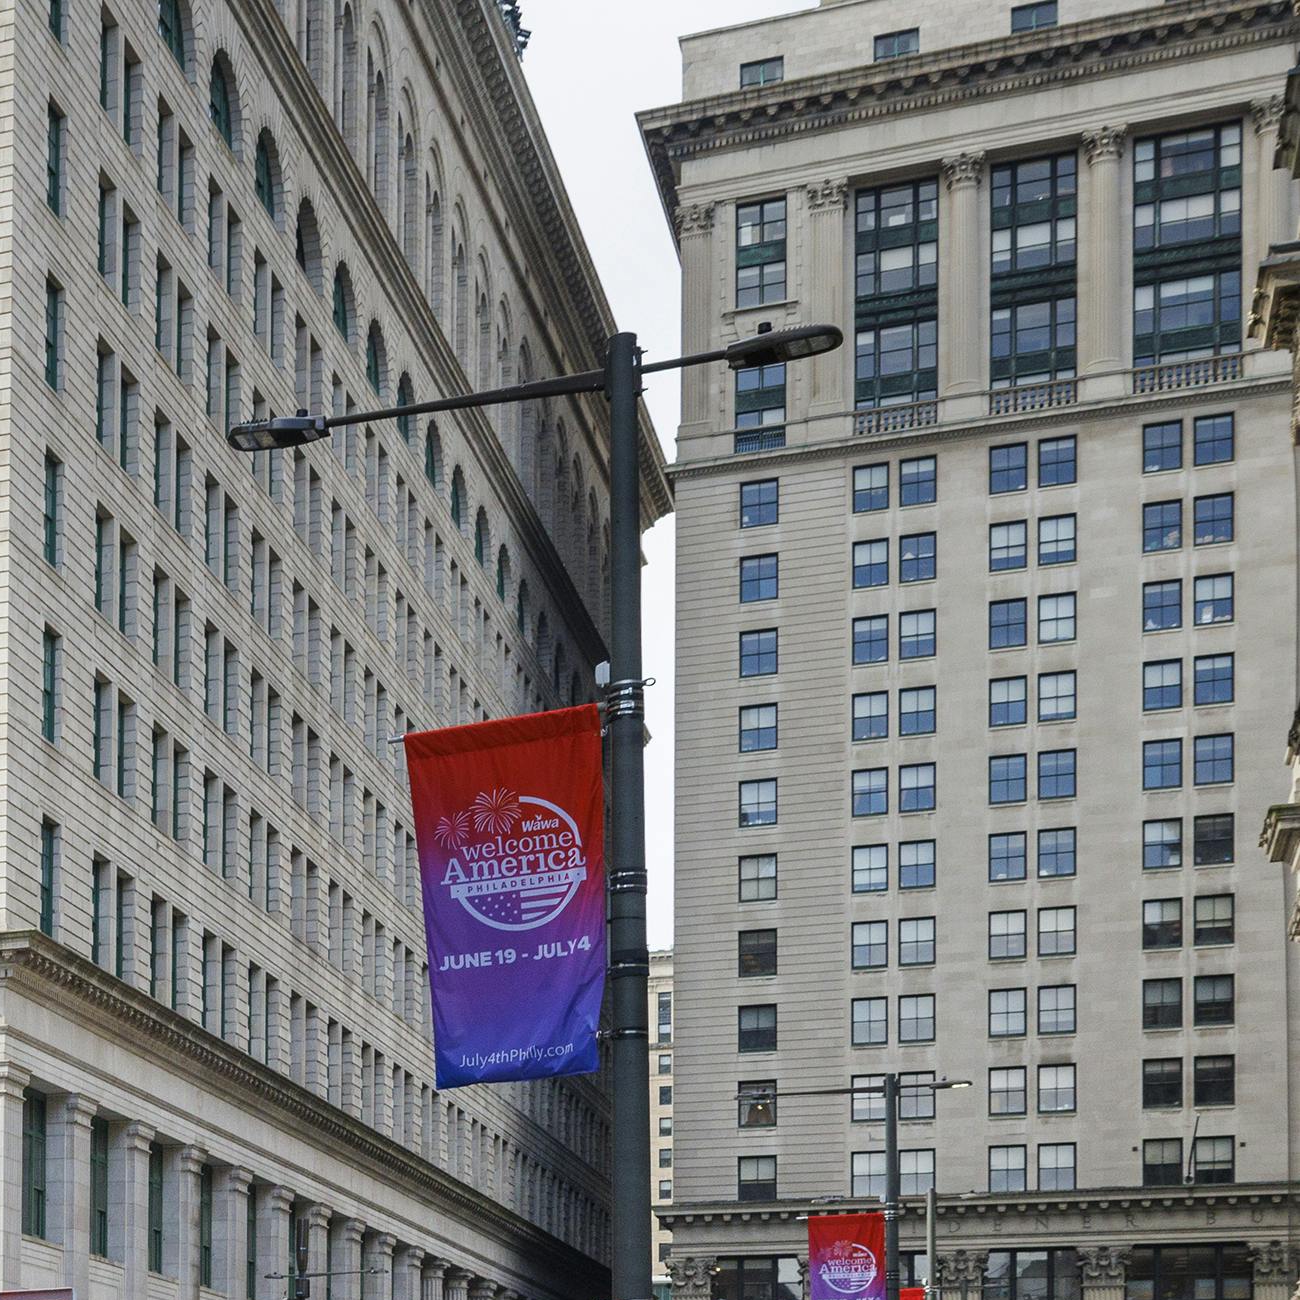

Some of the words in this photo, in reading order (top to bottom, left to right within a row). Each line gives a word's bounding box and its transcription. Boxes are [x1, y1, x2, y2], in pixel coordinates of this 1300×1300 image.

[461, 831, 573, 861] welcome
[440, 847, 587, 885] America
[467, 873, 570, 893] PHILADELPHIA
[440, 951, 492, 971] JUNE
[495, 948, 517, 964] 19
[533, 941, 577, 960] JULY
[577, 935, 591, 950] 4
[460, 1043, 574, 1069] July4thPhilly.com
[819, 1264, 877, 1274] America
